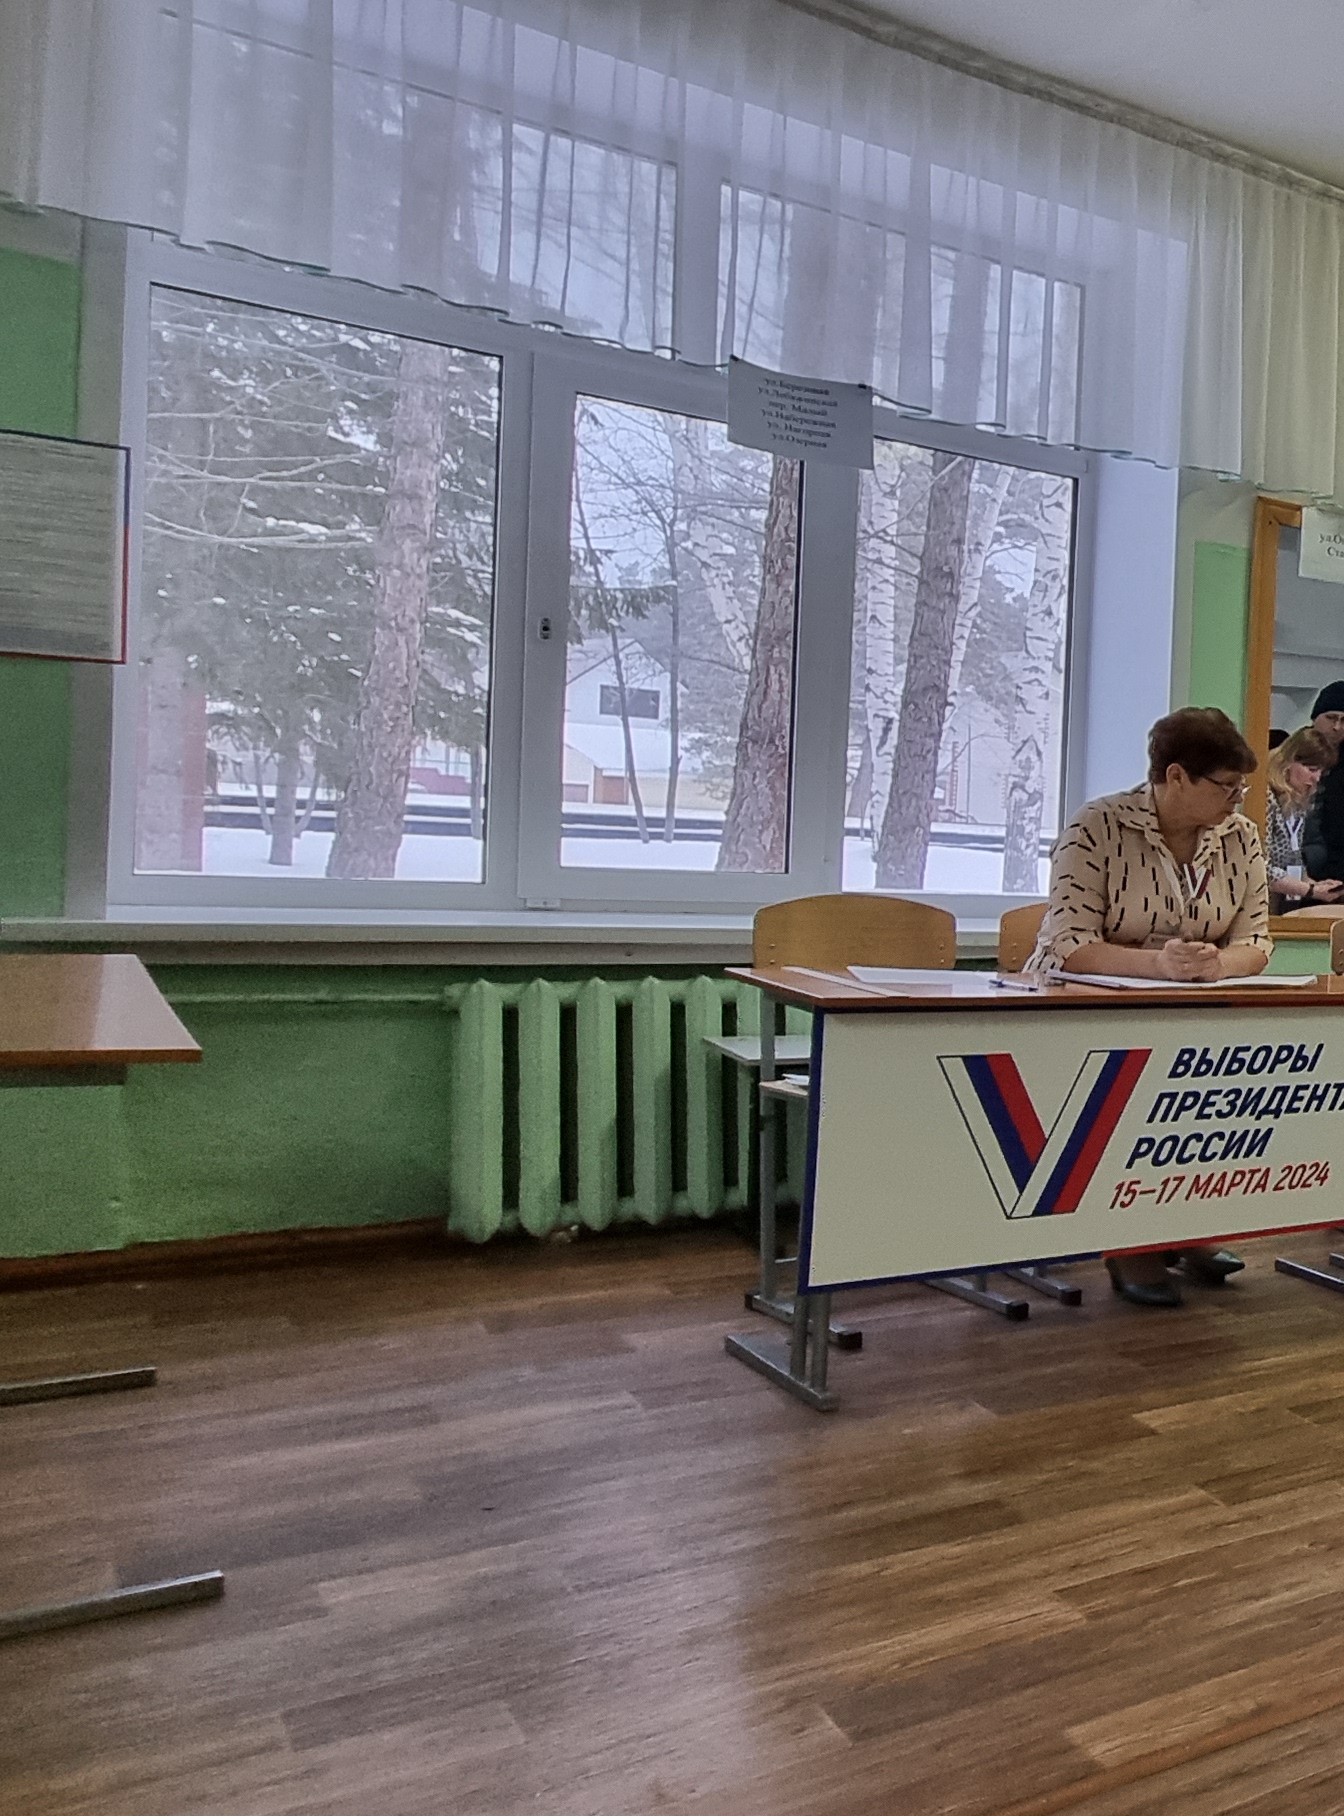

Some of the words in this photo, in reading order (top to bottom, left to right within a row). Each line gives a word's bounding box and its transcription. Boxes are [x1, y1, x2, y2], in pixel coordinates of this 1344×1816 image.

[1167, 1043, 1324, 1079] ВЫБОРЫ
[1126, 1127, 1274, 1170] РОССИИ
[1184, 1167, 1271, 1201] МАРТА
[1272, 1161, 1329, 1192] 2024
